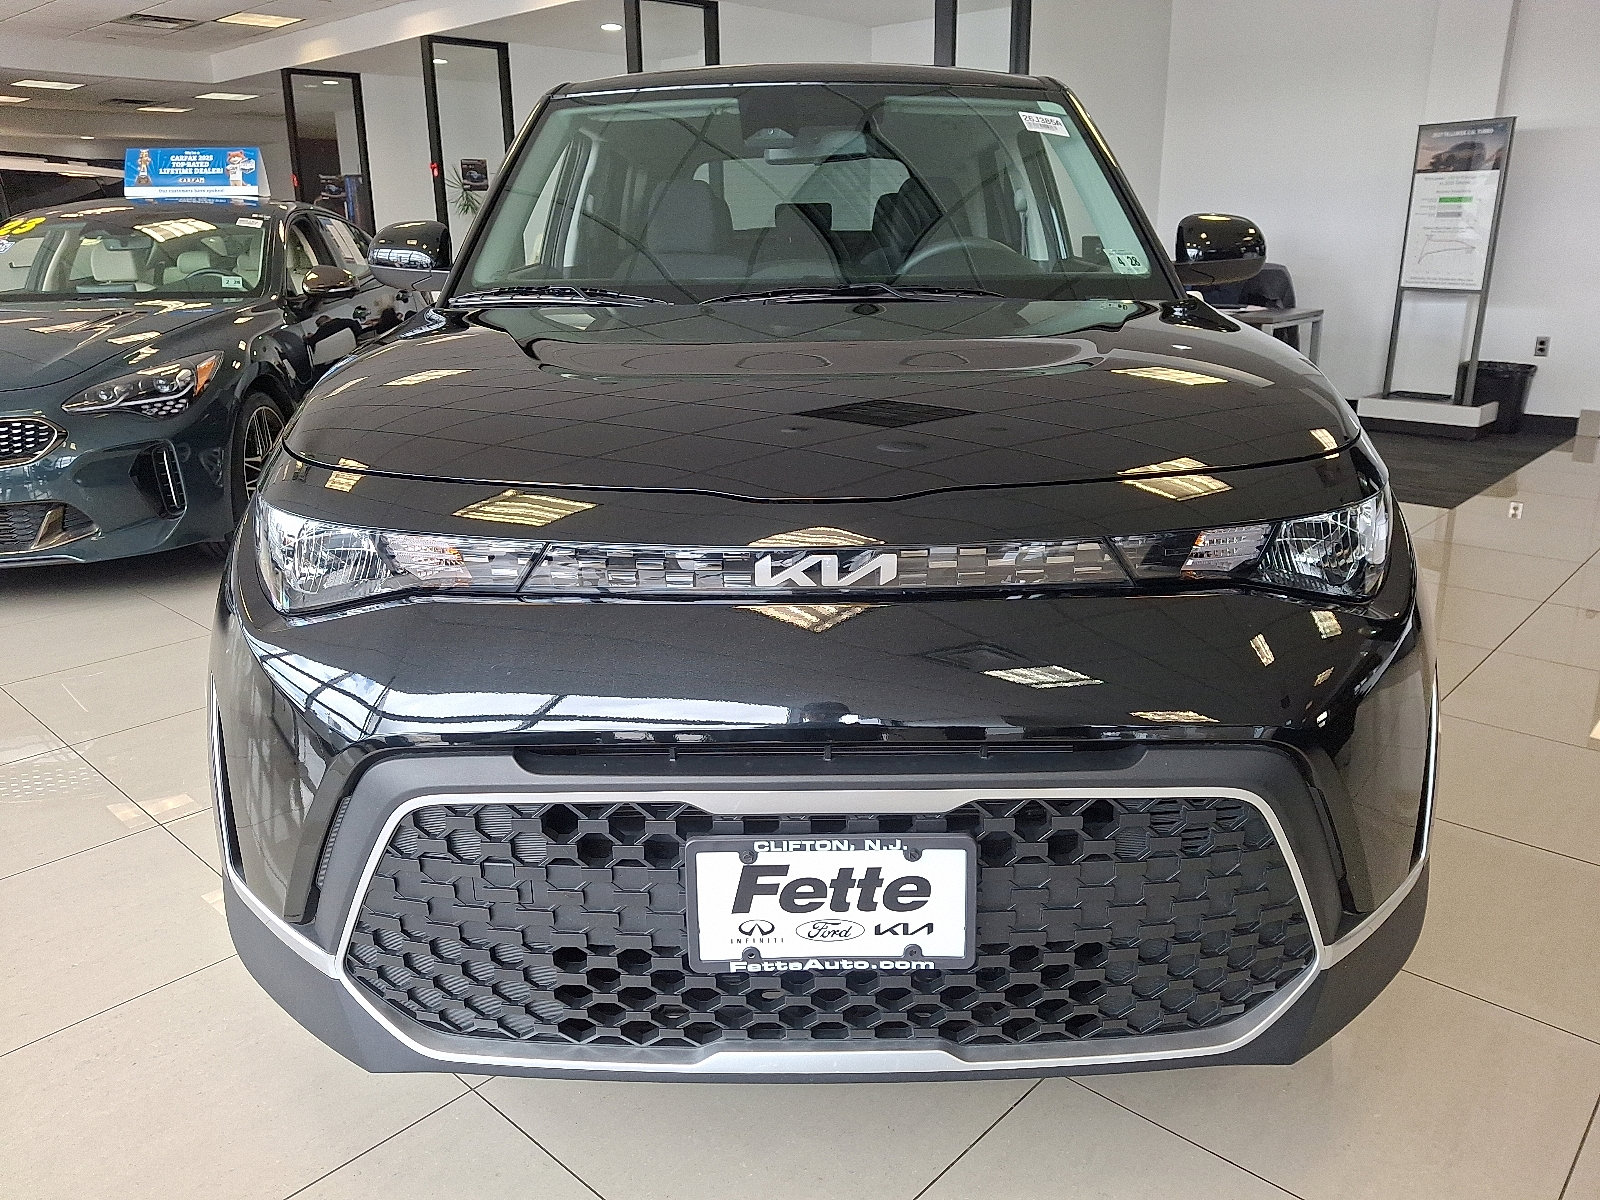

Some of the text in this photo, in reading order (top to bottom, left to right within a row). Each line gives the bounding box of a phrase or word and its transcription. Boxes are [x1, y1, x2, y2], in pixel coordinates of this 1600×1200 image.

[1117, 255, 1141, 267] 4 28
[754, 553, 898, 587] KIA
[753, 838, 909, 853] CLIFTON, N.J.
[731, 864, 932, 915] Fette
[807, 920, 853, 939] Ford
[874, 922, 934, 936] KIA
[728, 958, 936, 973] FetteAuto.com
